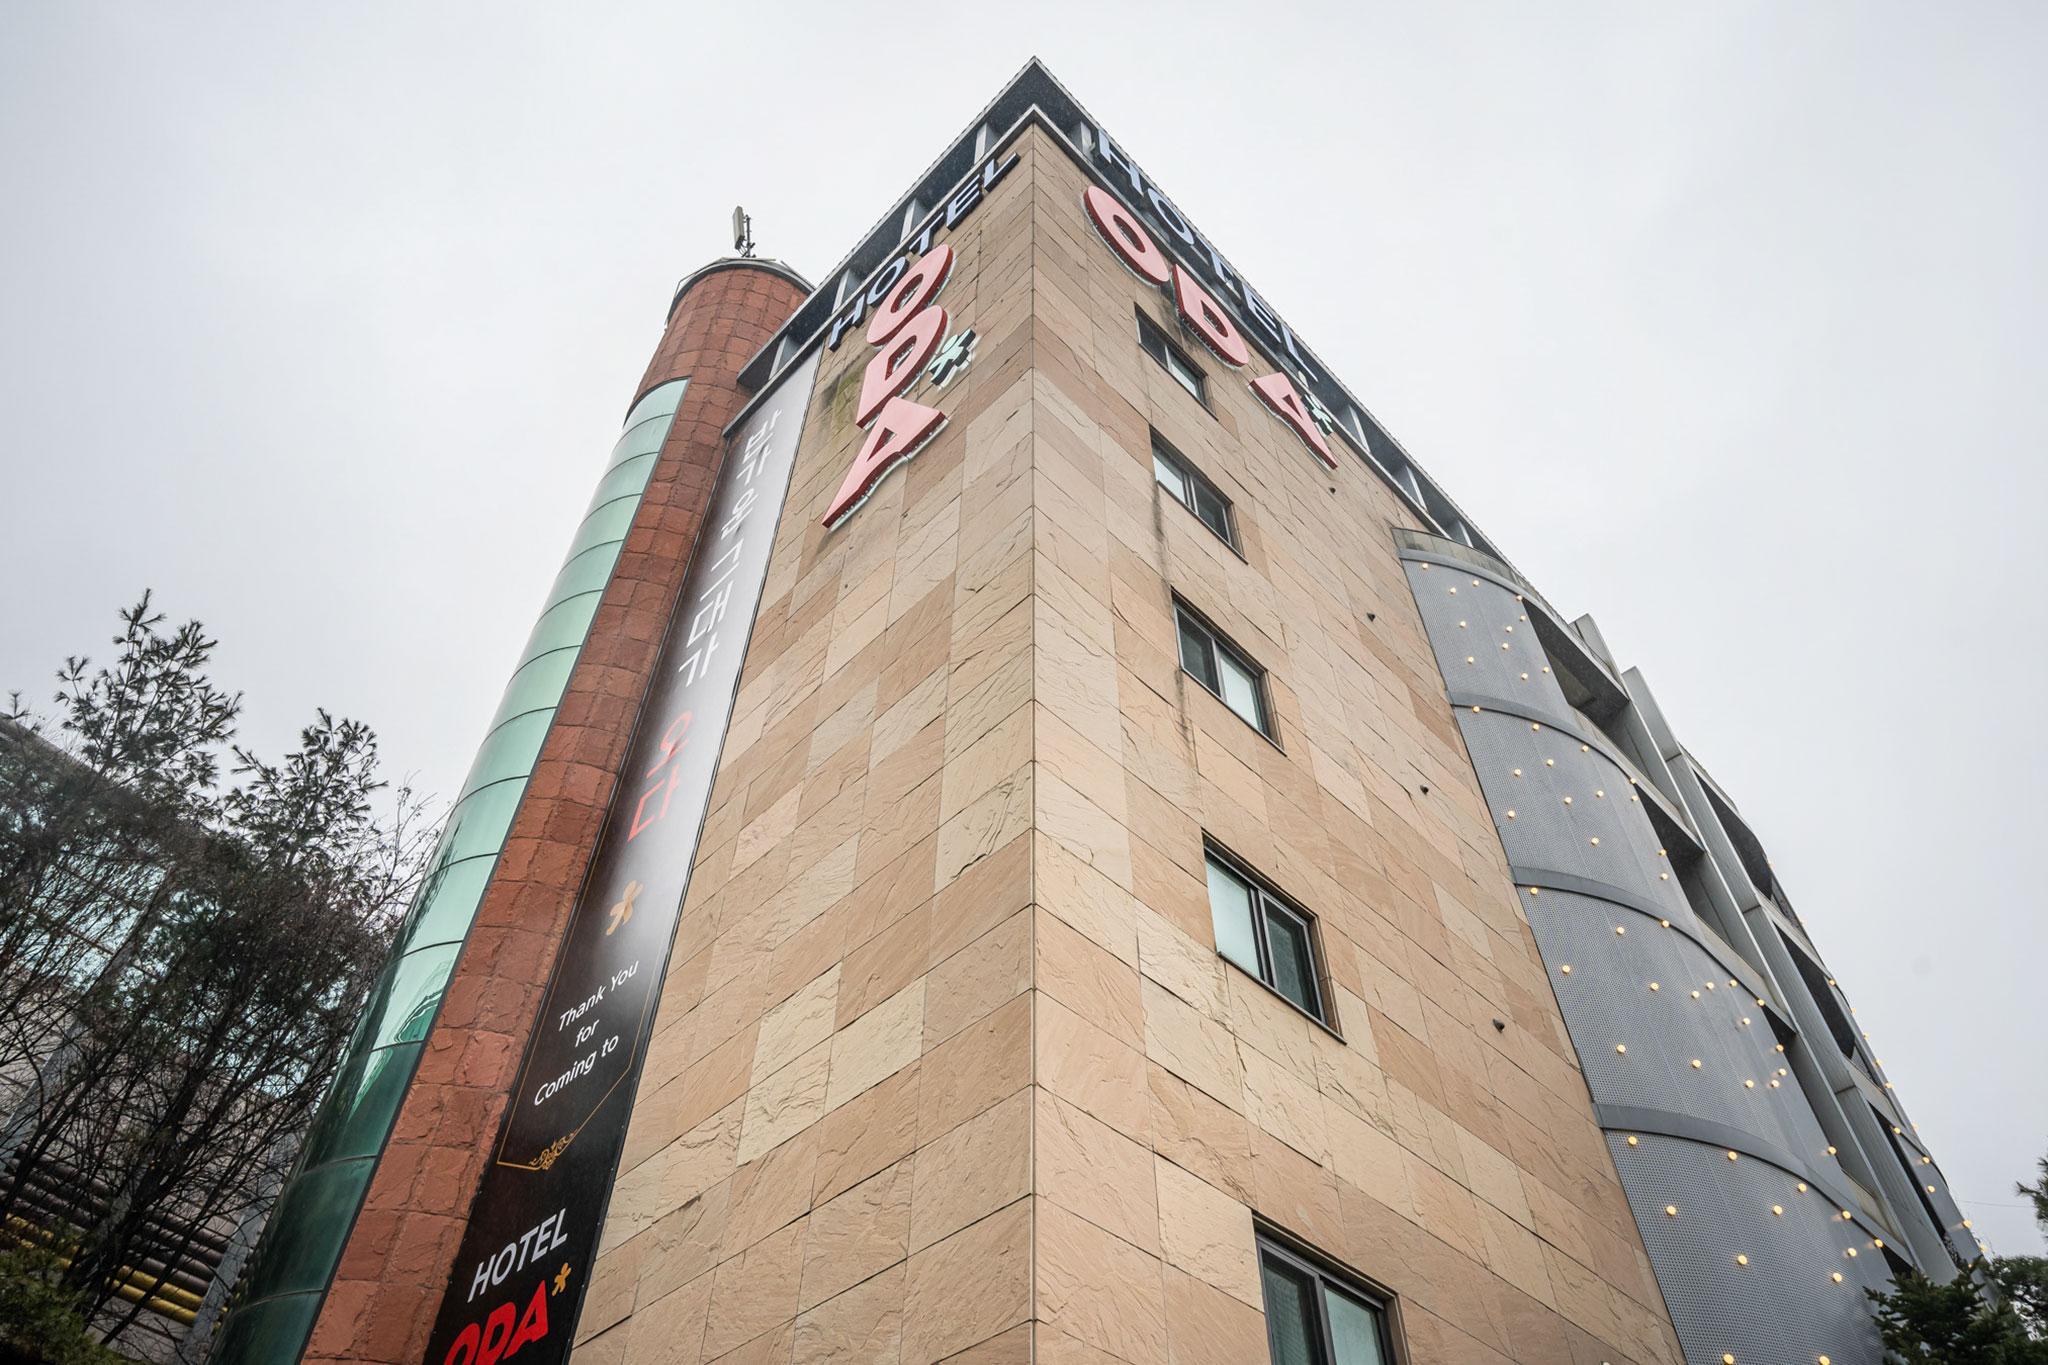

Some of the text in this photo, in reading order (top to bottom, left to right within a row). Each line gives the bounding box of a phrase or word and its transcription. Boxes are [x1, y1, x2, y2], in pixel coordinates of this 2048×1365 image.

[828, 151, 1021, 351] HOTEL
[1099, 131, 1318, 382] HOTEL
[822, 244, 953, 528] ODA
[1084, 185, 1338, 470] ODA
[627, 409, 782, 842] 반가운 그대가 오다
[558, 959, 639, 1032] Thank You
[574, 1019, 600, 1047] for
[534, 1035, 619, 1106] Coming to
[443, 1280, 549, 1365] ODA
[467, 1207, 568, 1303] HOTEL
